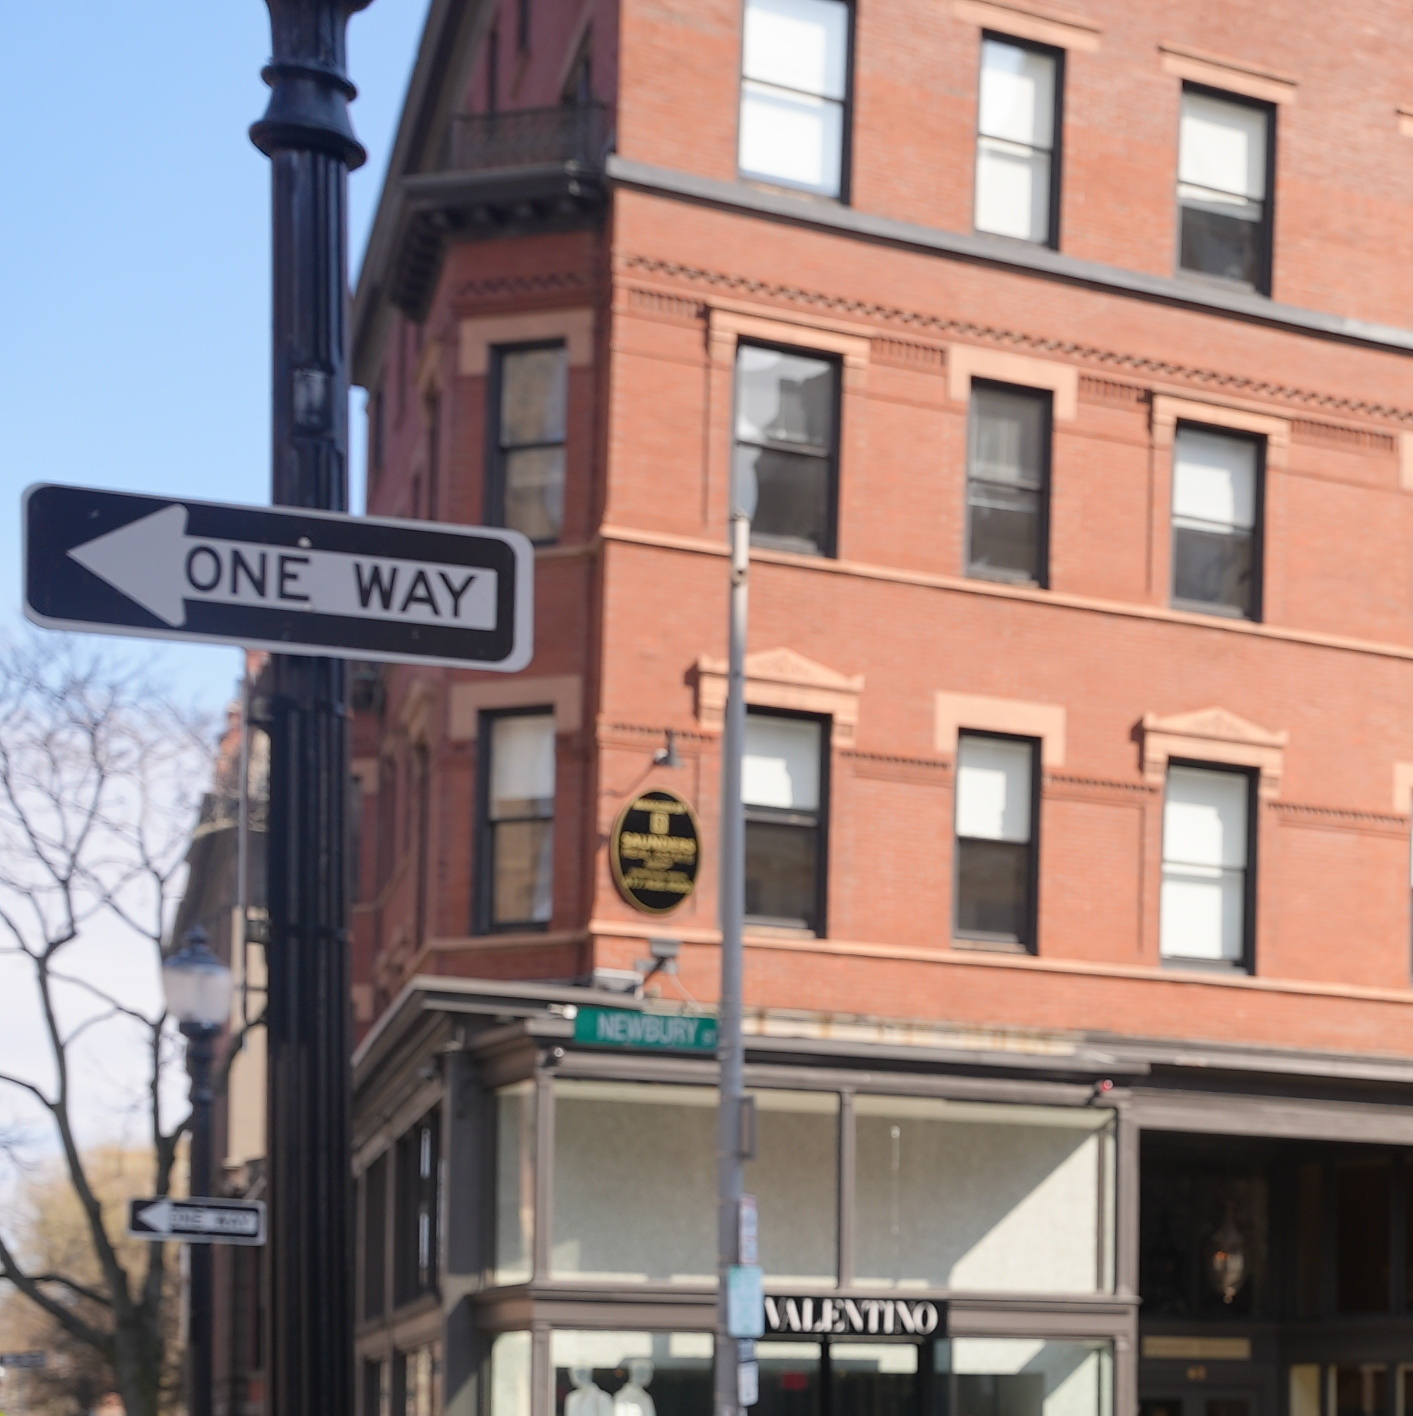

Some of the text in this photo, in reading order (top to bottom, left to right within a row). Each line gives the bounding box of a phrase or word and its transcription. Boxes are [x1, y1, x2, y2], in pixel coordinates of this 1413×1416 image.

[185, 545, 477, 618] ONE WAY
[597, 1011, 699, 1045] NEWBURY
[764, 1295, 939, 1336] VALENTINO
